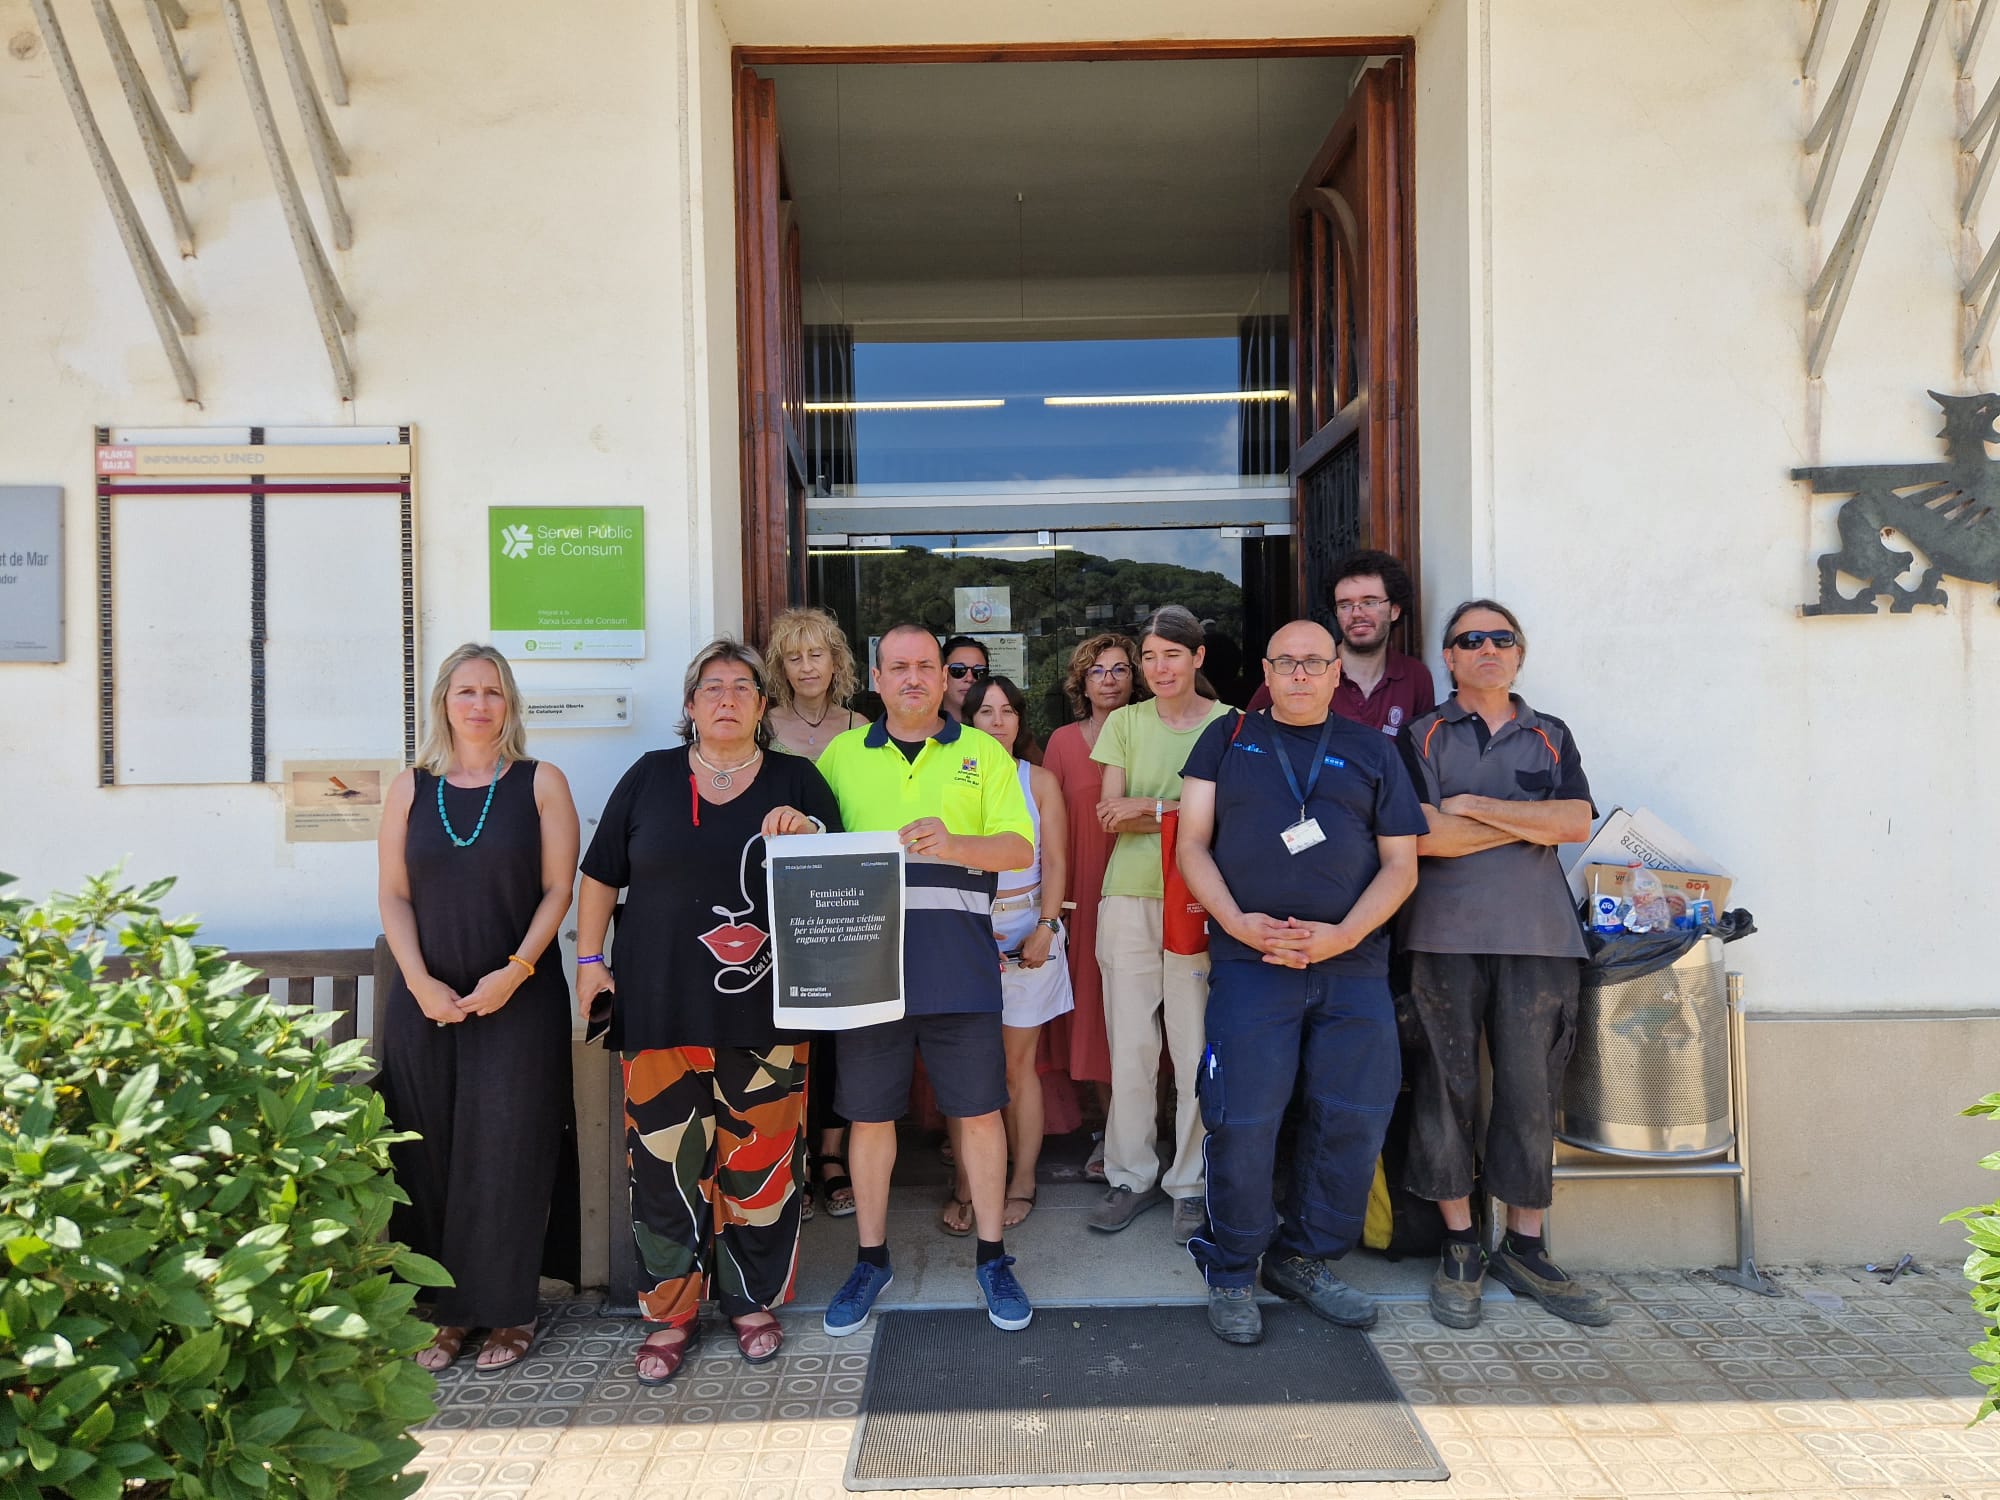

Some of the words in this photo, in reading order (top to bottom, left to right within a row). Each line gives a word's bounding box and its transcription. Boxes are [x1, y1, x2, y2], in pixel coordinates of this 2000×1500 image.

[98, 451, 133, 460] PLANTA
[224, 453, 264, 464] UNED
[102, 461, 131, 470] BAIXA
[537, 525, 583, 540] Servei
[588, 524, 633, 540] Públic
[537, 543, 557, 556] de
[561, 543, 623, 556] Consum
[9, 552, 23, 567] de
[26, 551, 49, 567] Mar
[538, 617, 560, 625] Xarxa
[561, 617, 583, 625] Local
[584, 617, 594, 625] de
[595, 616, 628, 625] Consum
[810, 887, 857, 899] Feminicidi
[815, 897, 860, 908] Barcelona
[790, 917, 805, 926] Ella
[806, 916, 815, 925] és
[816, 916, 824, 925] la
[825, 917, 855, 925] novena
[856, 913, 886, 923] víctima
[794, 927, 808, 936] per
[809, 924, 844, 935] violència
[846, 923, 882, 933] masclista
[795, 935, 829, 945] enguany
[837, 932, 880, 943] Catalunya.
